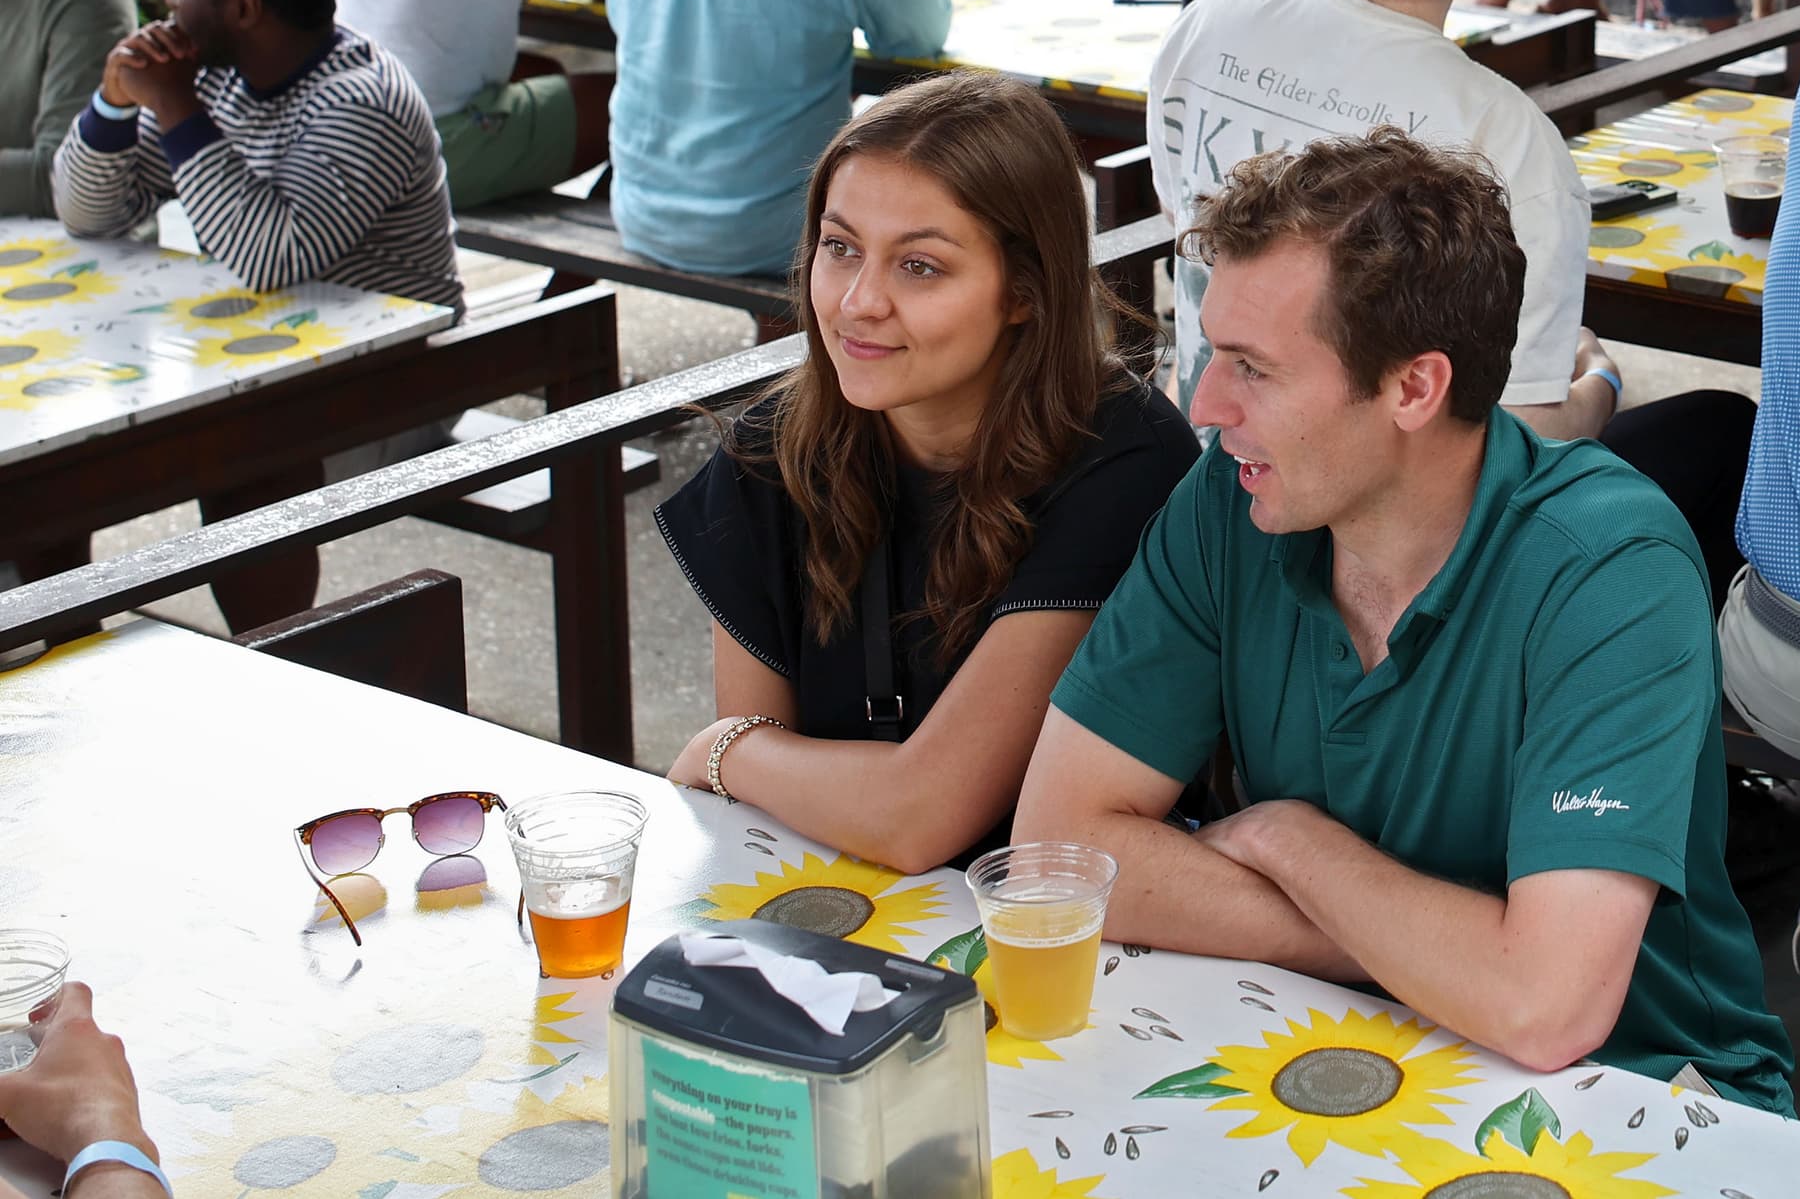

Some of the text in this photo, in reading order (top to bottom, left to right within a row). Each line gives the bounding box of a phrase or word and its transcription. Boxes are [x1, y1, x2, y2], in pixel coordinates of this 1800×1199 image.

[1219, 52, 1250, 83] The
[1257, 66, 1317, 106] Elder
[1318, 88, 1394, 125] Scrolls
[1552, 786, 1630, 816] Walter Hagen
[652, 1069, 798, 1121] everything on your tray is
